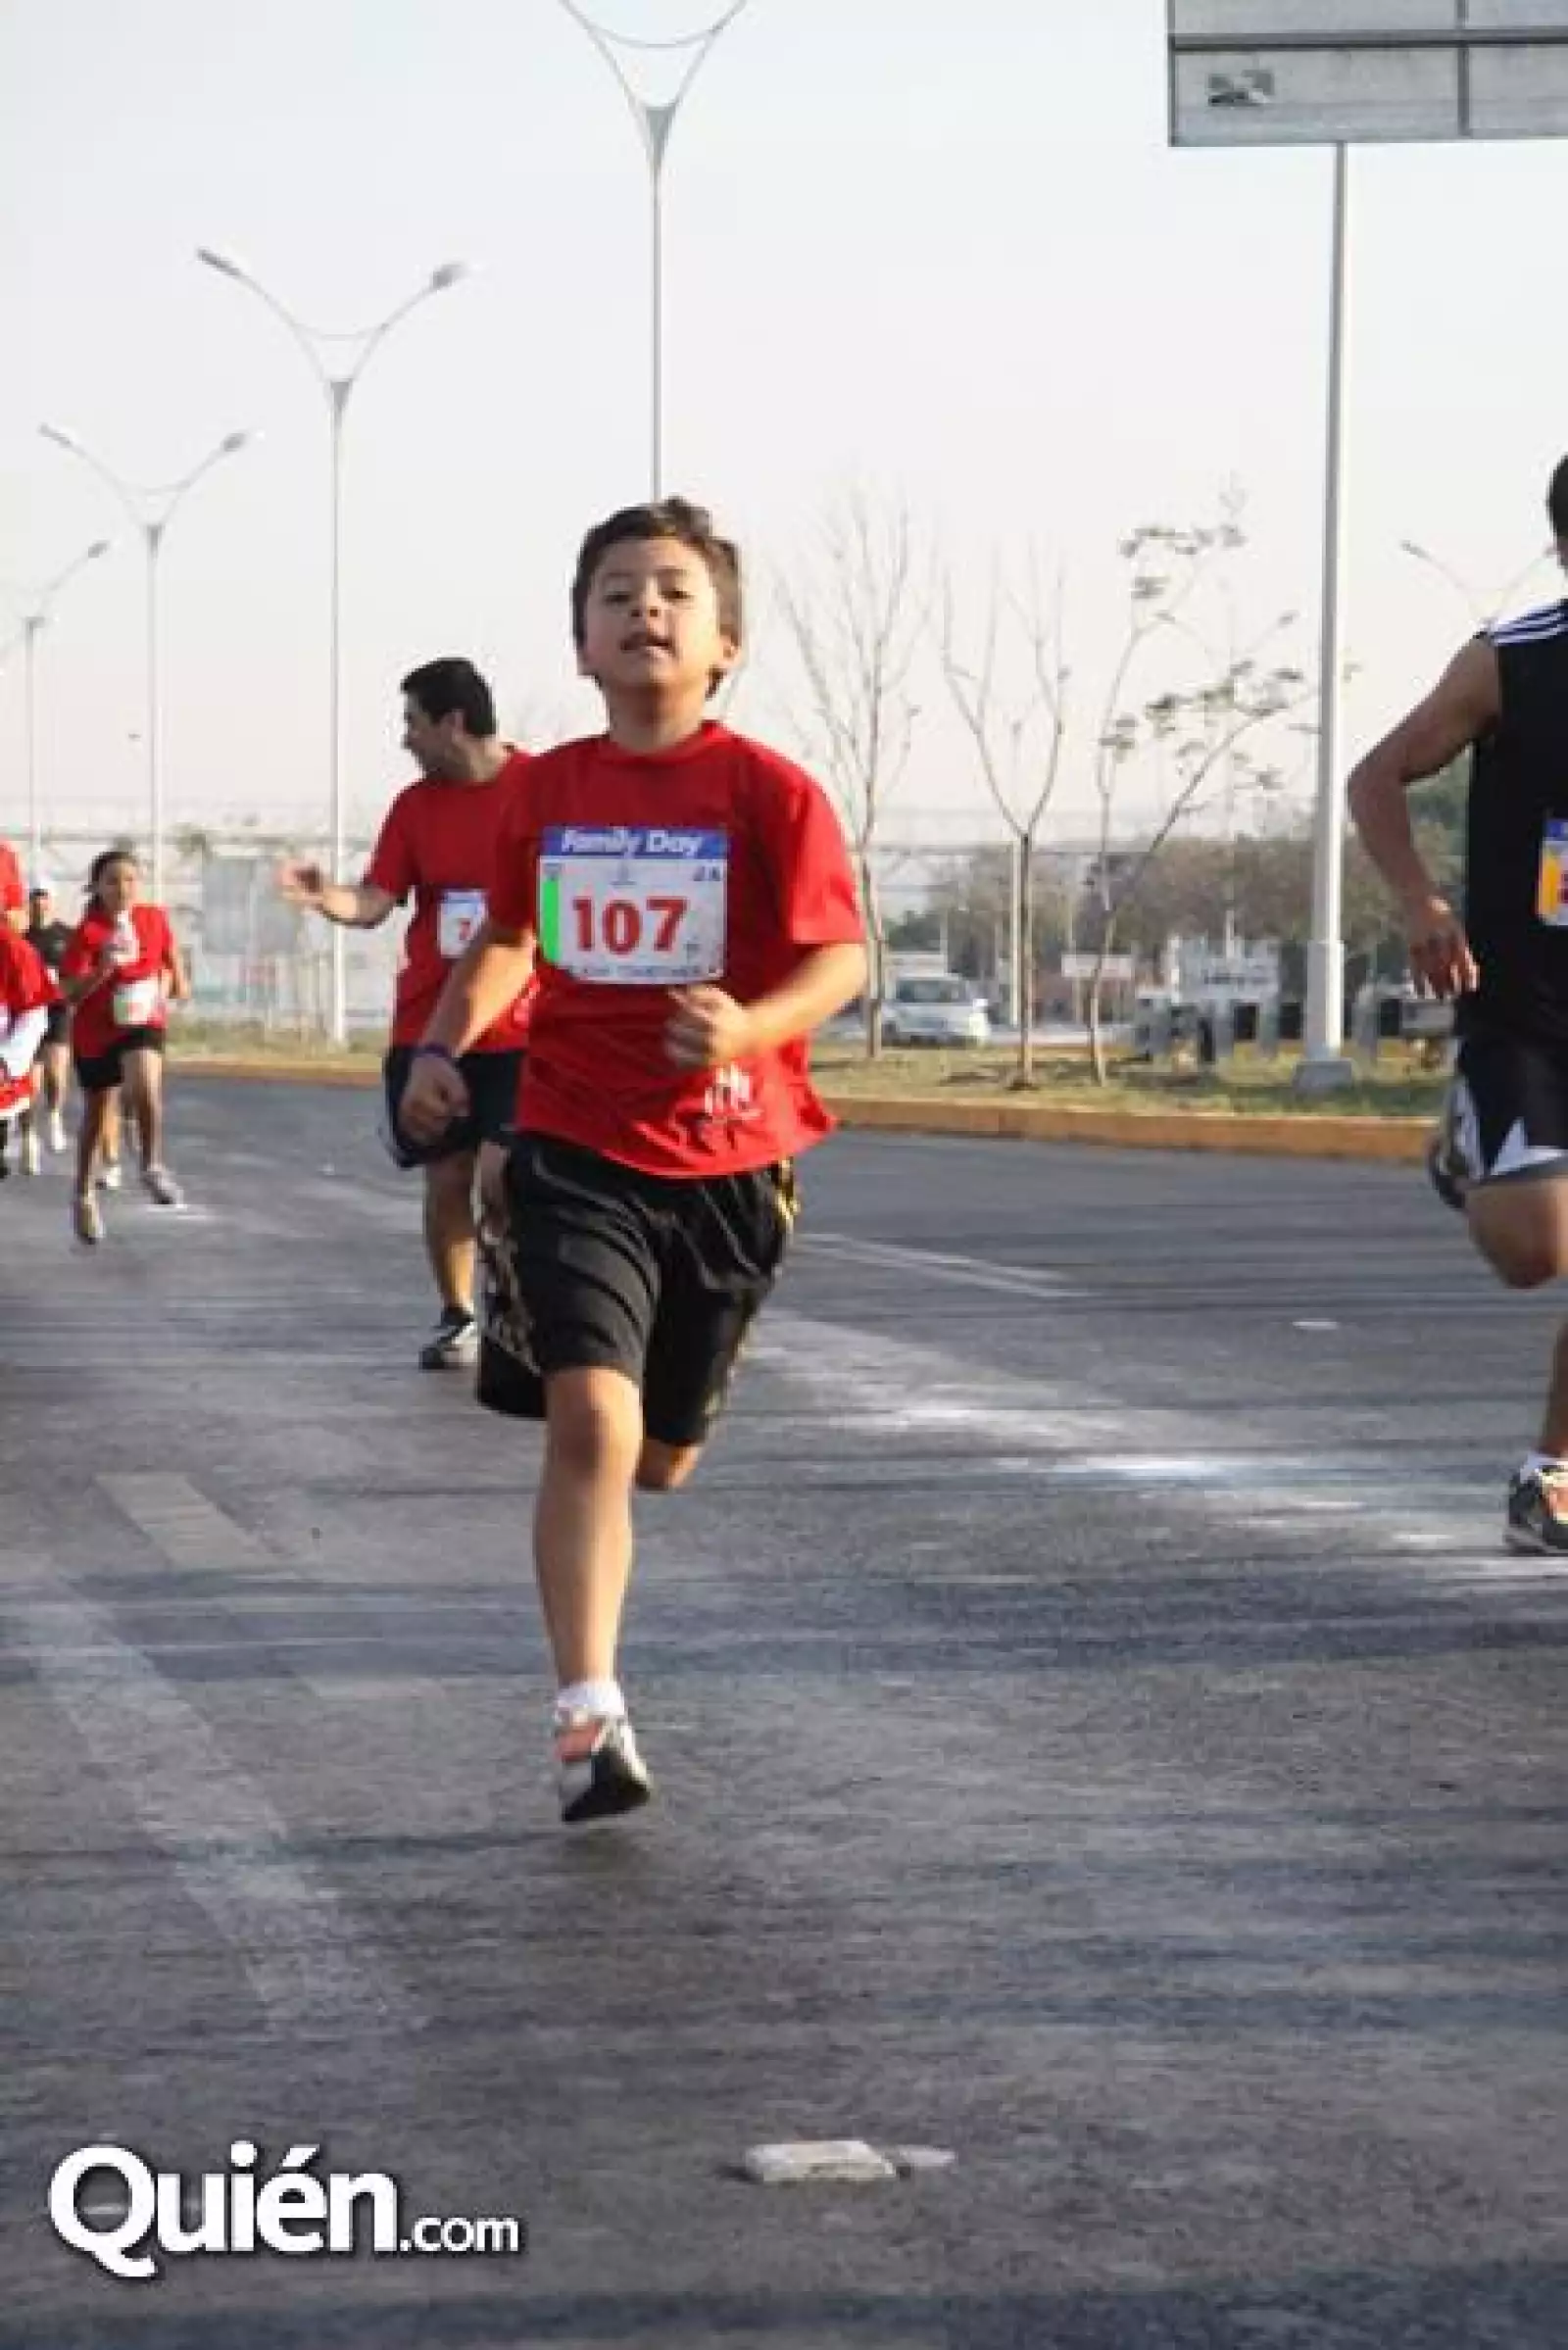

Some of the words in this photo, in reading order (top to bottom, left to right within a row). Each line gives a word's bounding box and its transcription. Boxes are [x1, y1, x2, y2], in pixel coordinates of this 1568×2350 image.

[562, 827, 640, 858] Family
[647, 829, 703, 857] Day
[572, 897, 688, 955] 107
